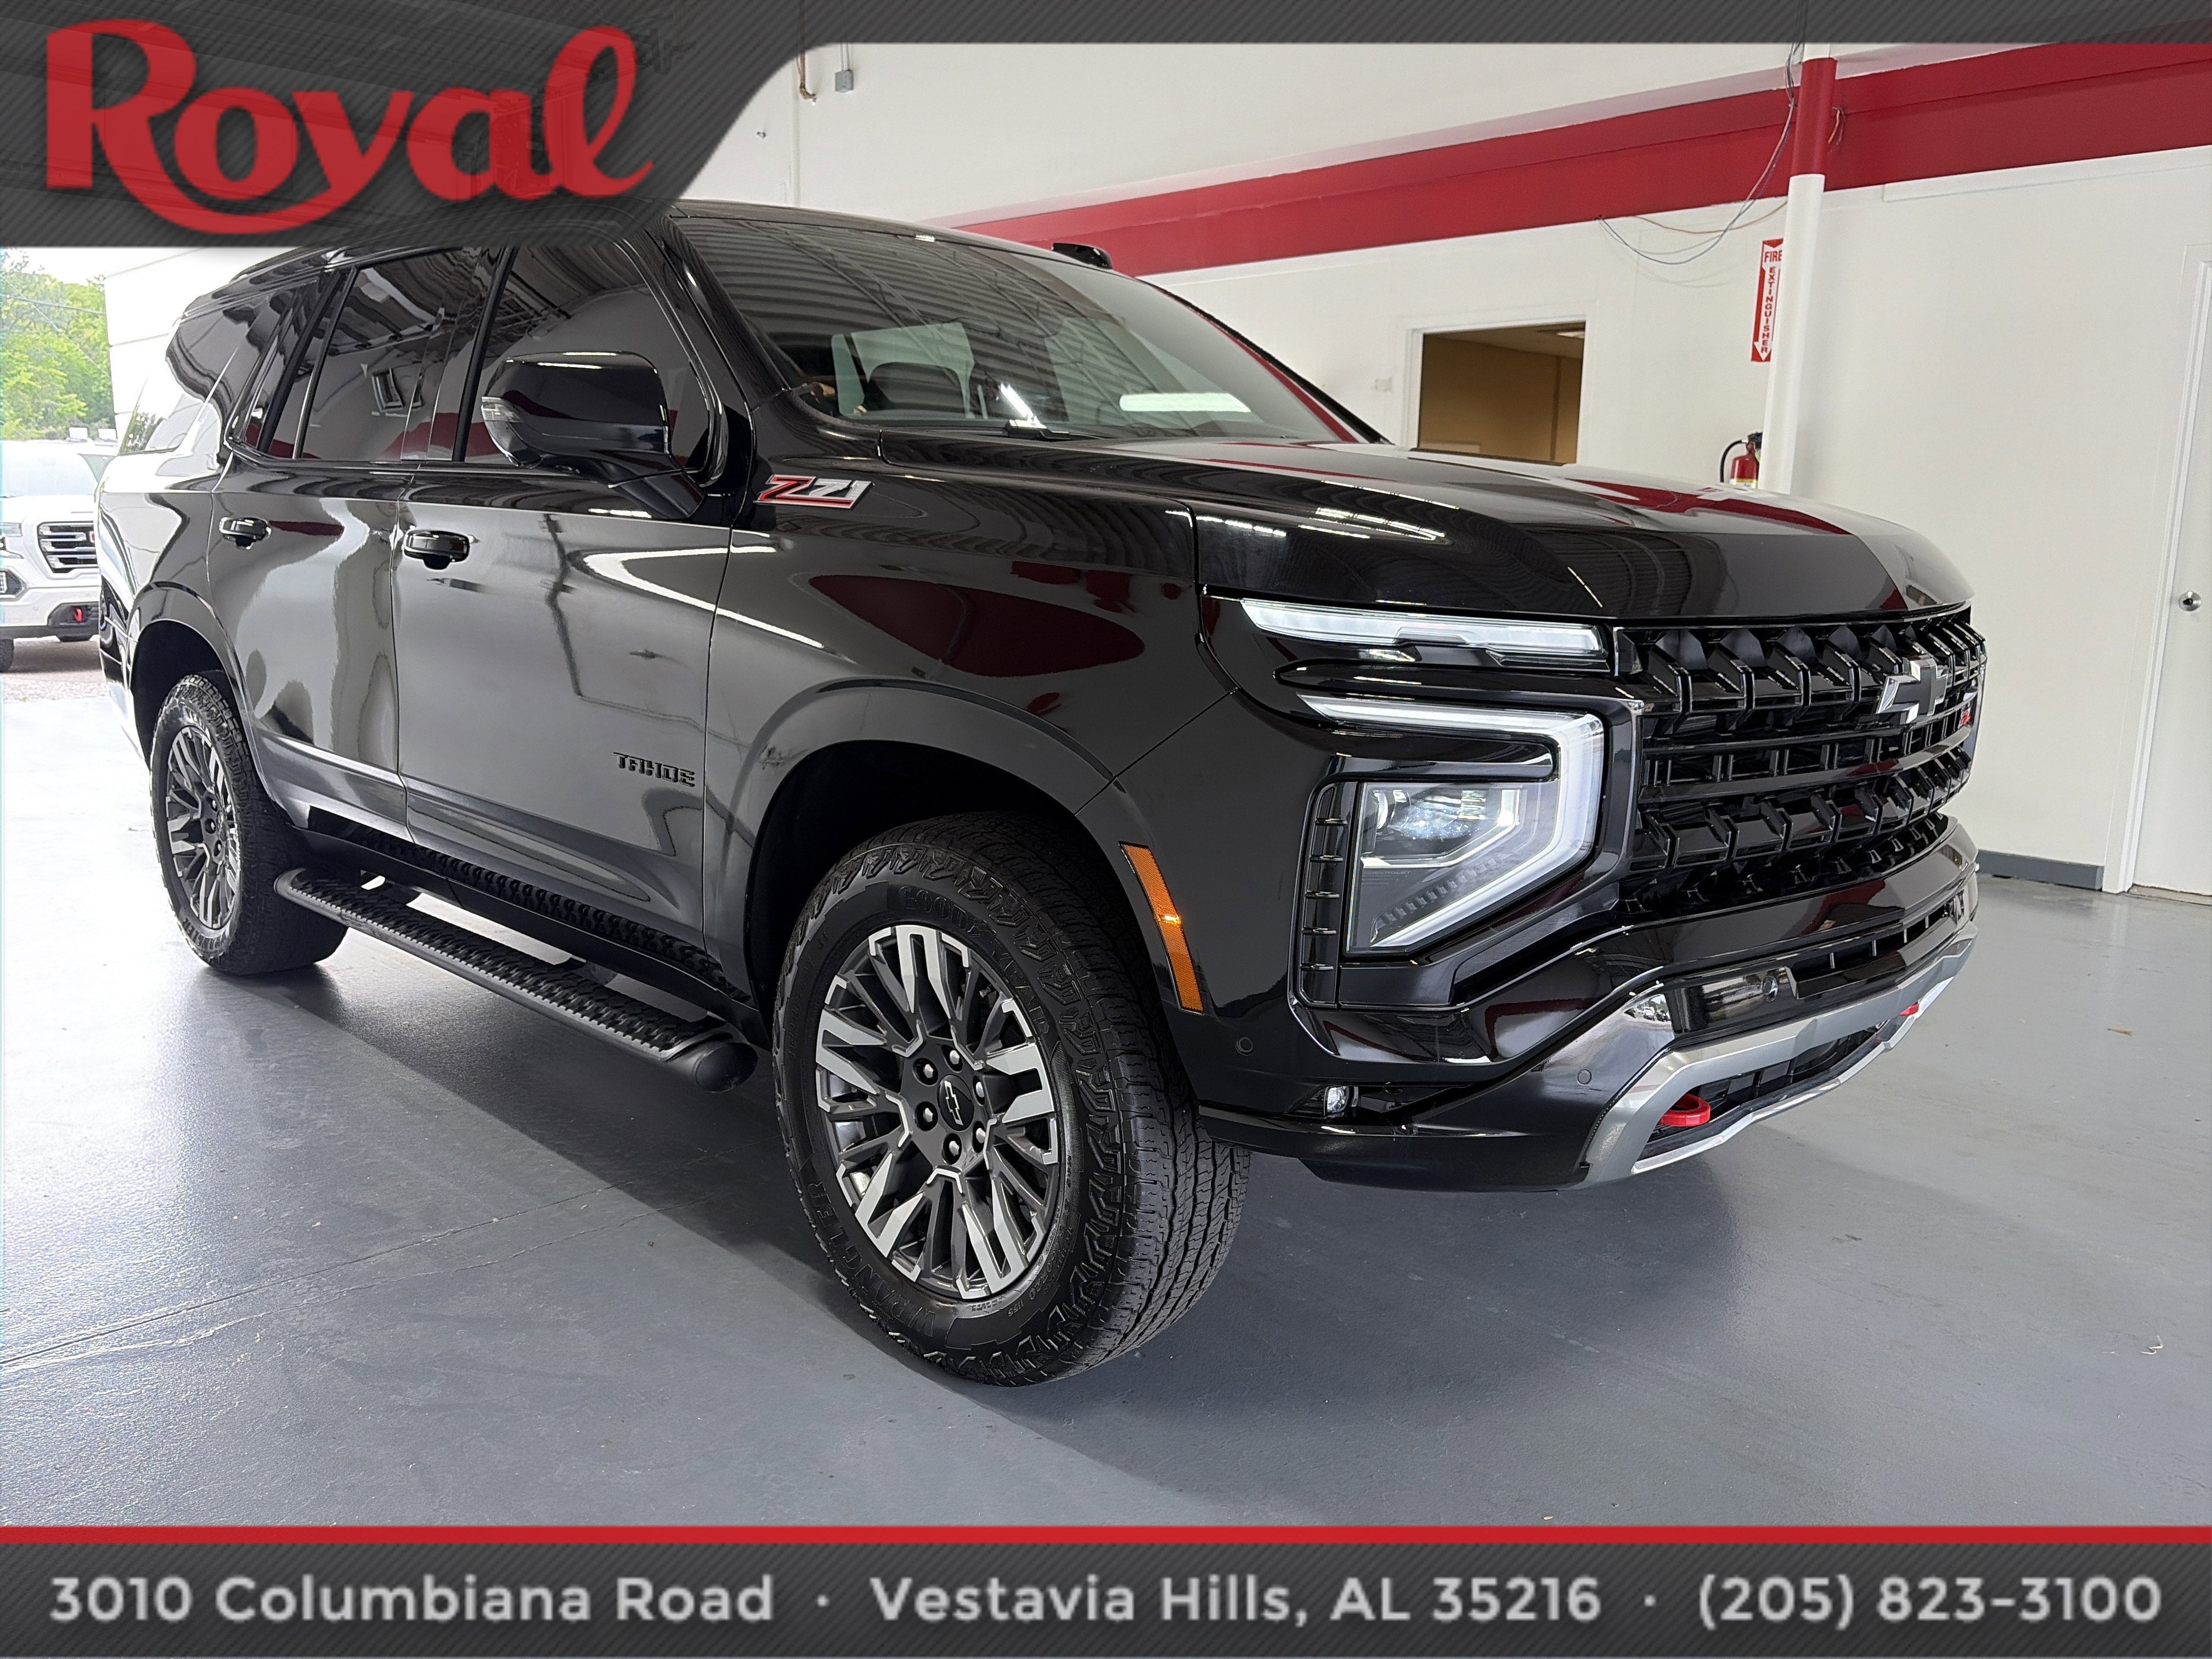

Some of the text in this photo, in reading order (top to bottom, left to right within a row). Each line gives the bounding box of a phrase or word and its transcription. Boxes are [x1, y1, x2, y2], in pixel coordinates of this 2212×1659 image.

[1764, 250, 1782, 263] FIRE
[1761, 266, 1776, 353] EXTINGUISHER
[753, 474, 872, 509] Z71
[612, 751, 696, 788] TAHOE
[807, 1181, 936, 1338] WRANGLER
